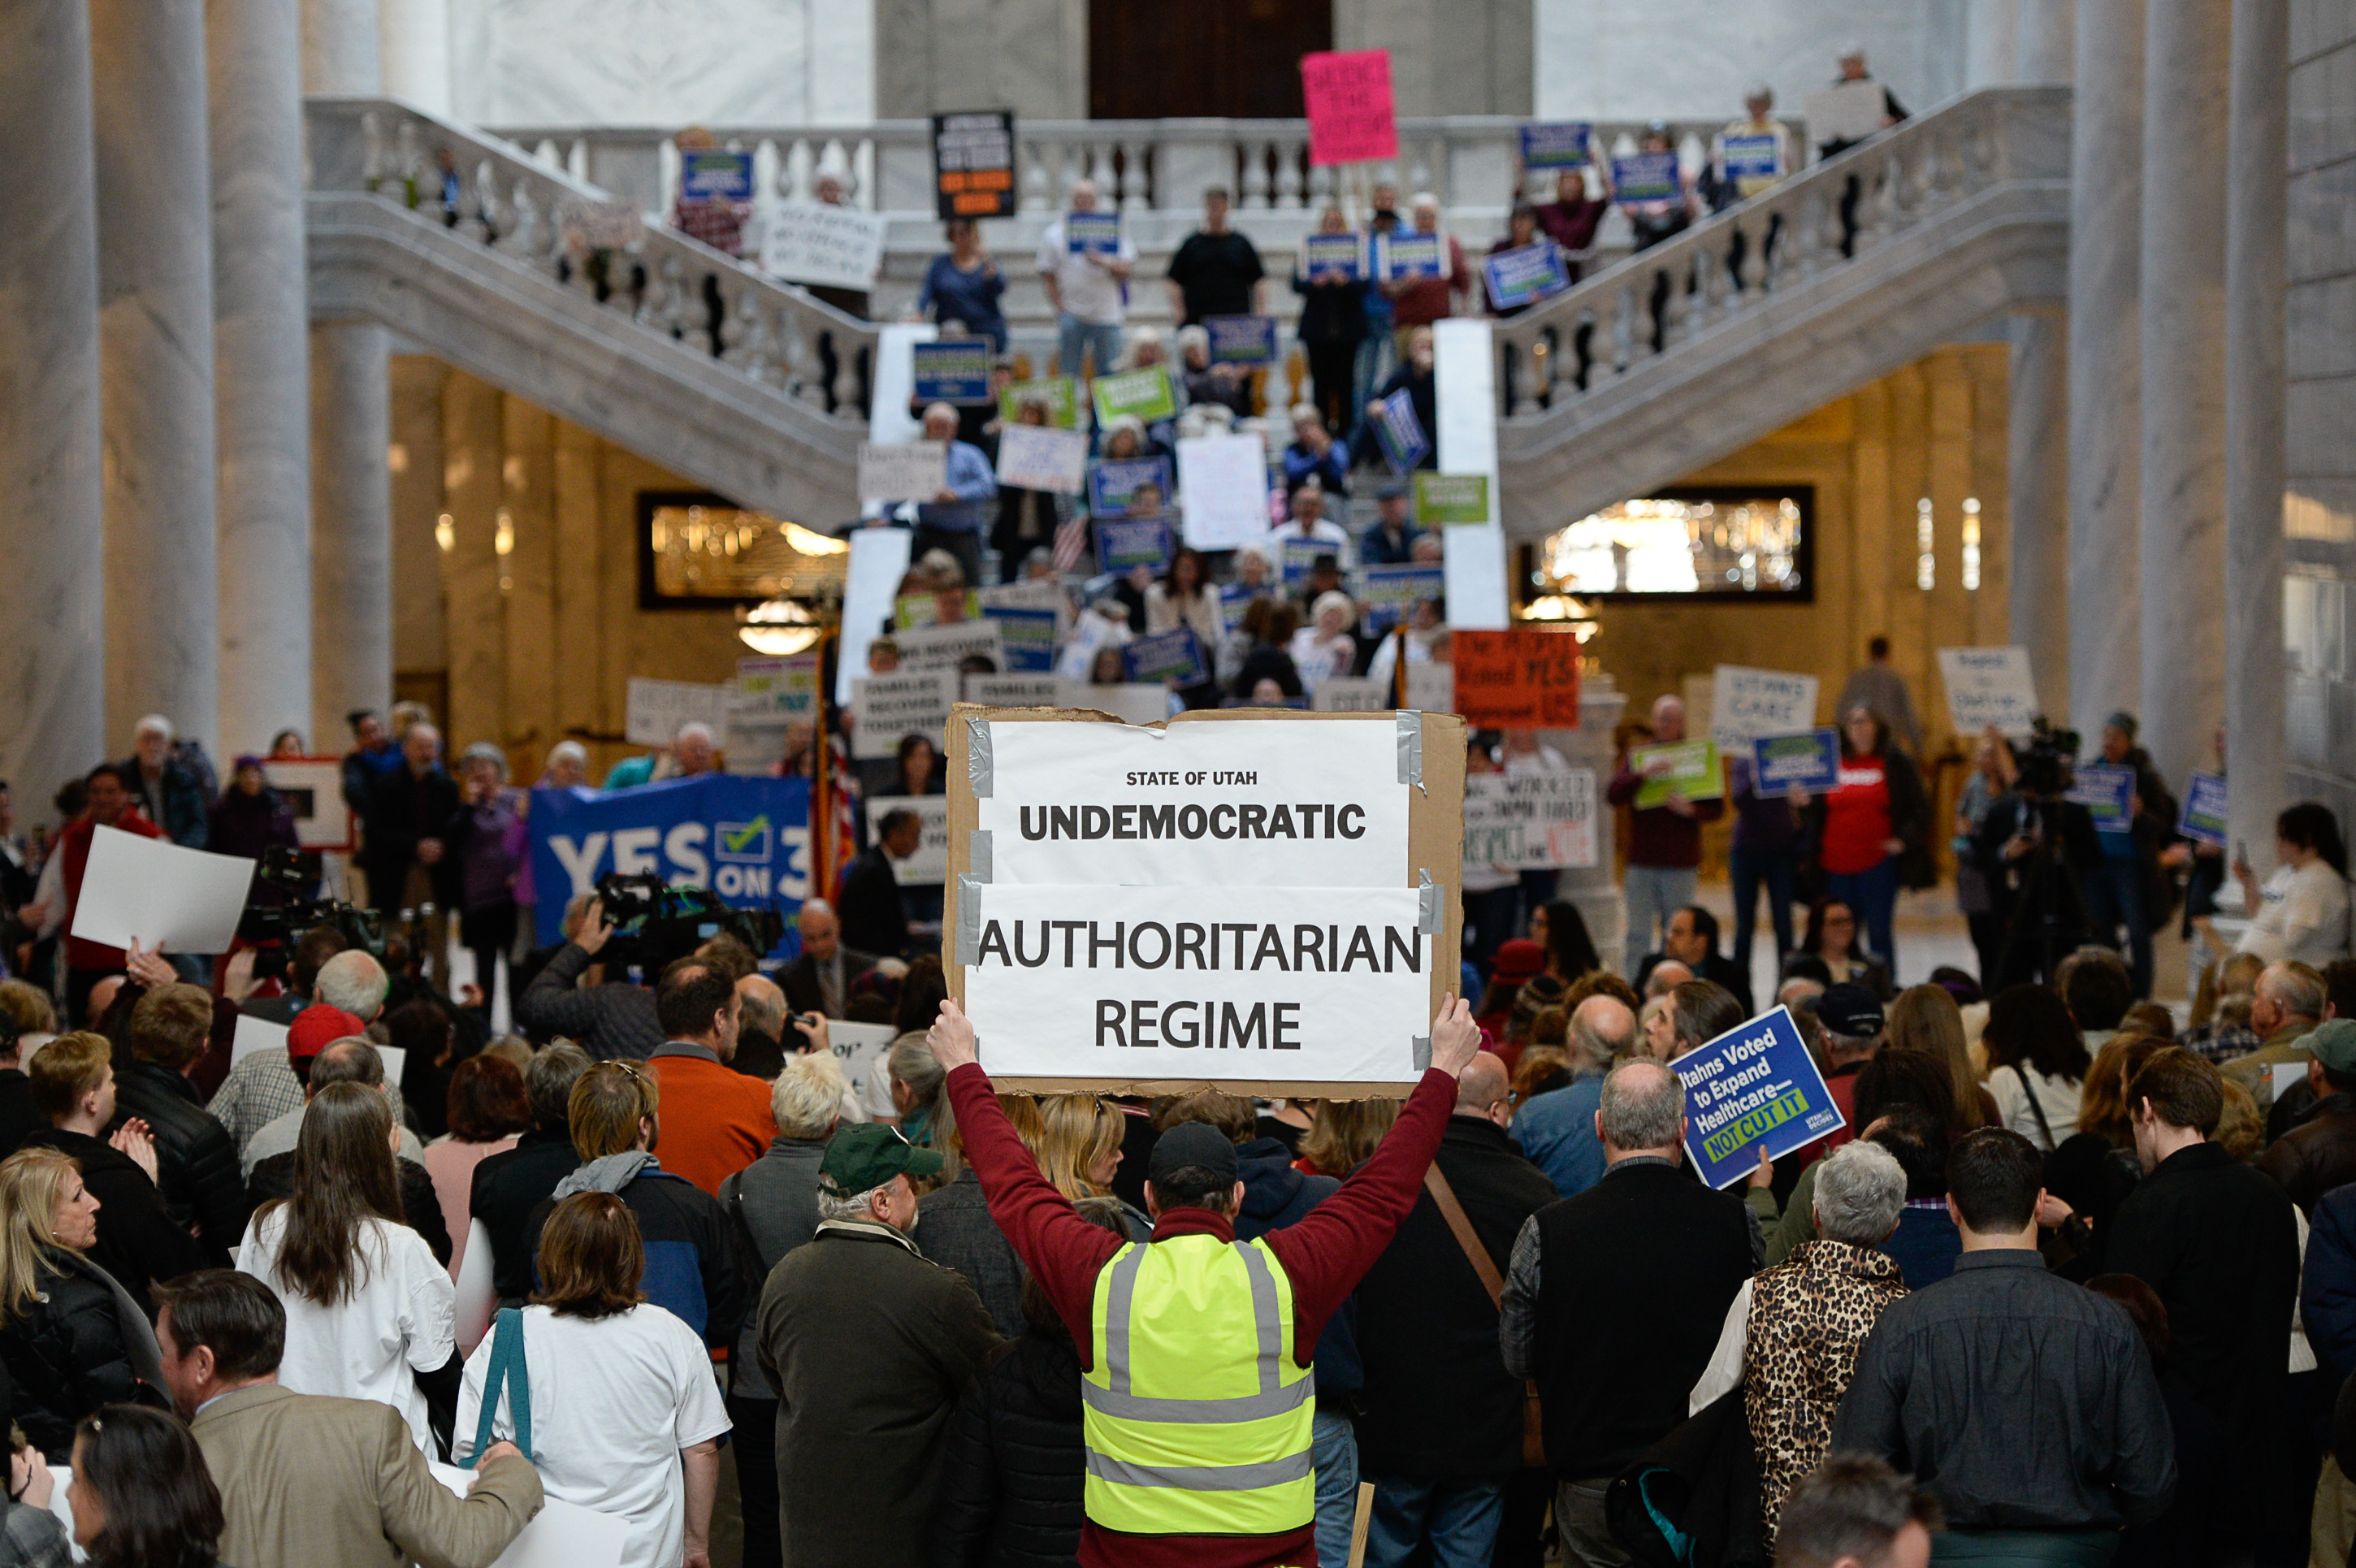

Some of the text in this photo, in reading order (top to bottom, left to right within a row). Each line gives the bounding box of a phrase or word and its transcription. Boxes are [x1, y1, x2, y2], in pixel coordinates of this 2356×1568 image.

[1126, 771, 1257, 786] STATE OF UTAH
[1020, 803, 1366, 841] UNDEMOCRATIC
[547, 821, 811, 900] YES ON 3
[978, 919, 1422, 973] AUTHORITARIAN
[1095, 999, 1301, 1050] REGIME
[1722, 1027, 1778, 1065] Voted
[1694, 1056, 1772, 1109] to Expand
[1708, 1093, 1800, 1159] NOT CUT IT
